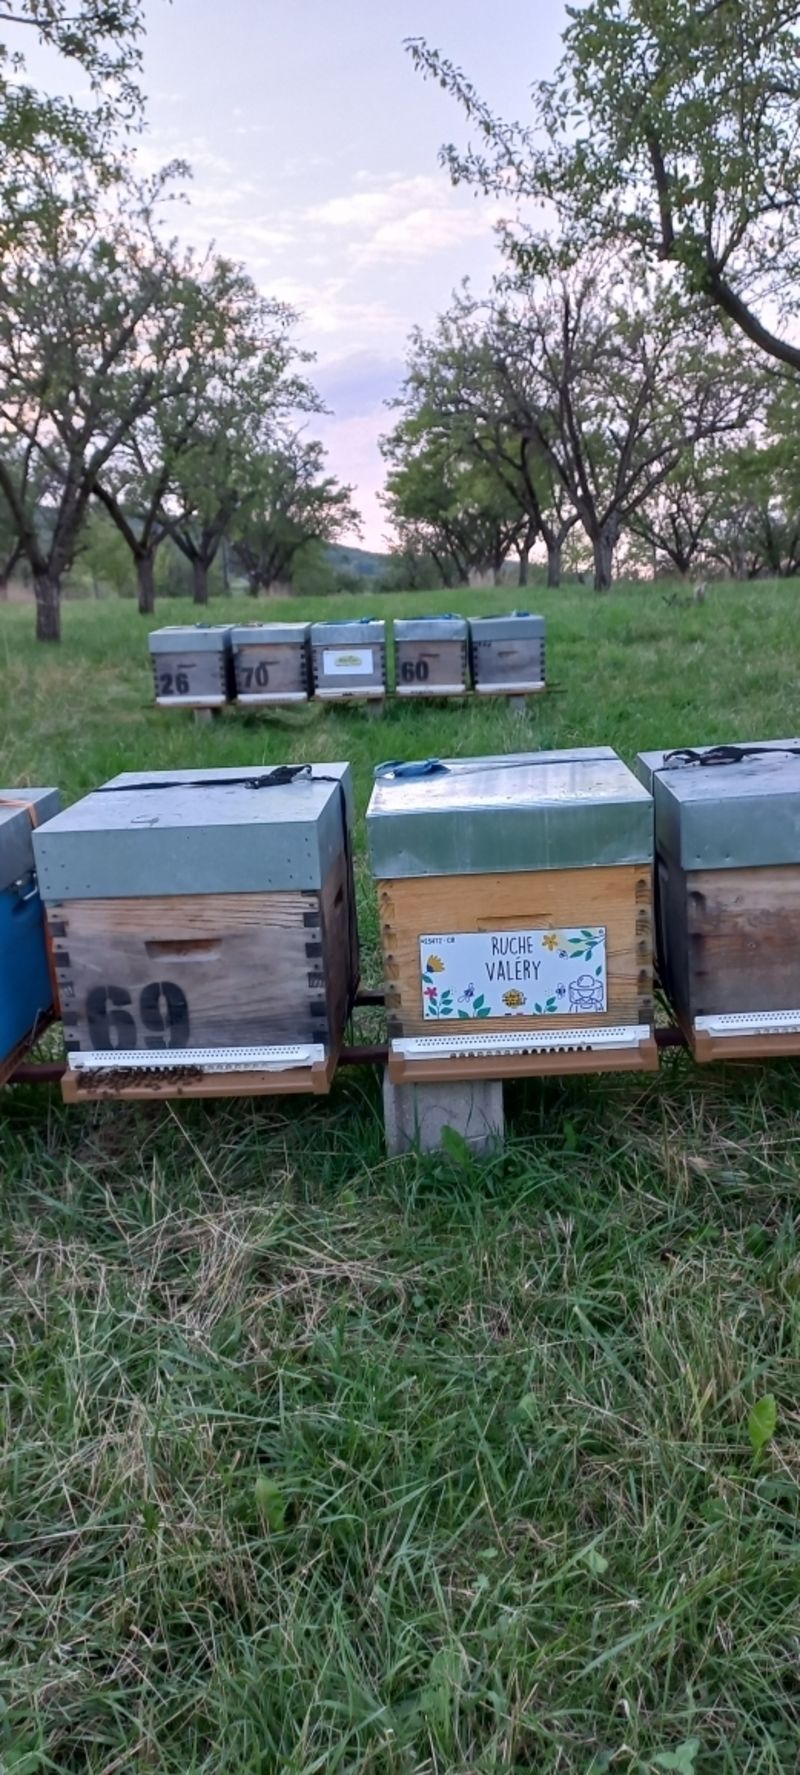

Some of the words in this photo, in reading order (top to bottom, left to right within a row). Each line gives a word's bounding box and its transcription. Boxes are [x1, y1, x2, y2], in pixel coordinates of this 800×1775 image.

[241, 664, 268, 687] 70
[401, 661, 429, 682] 60
[159, 673, 190, 694] 26
[491, 936, 533, 956] RUCHE
[485, 957, 541, 981] VALÉRY
[87, 982, 189, 1049] 69
